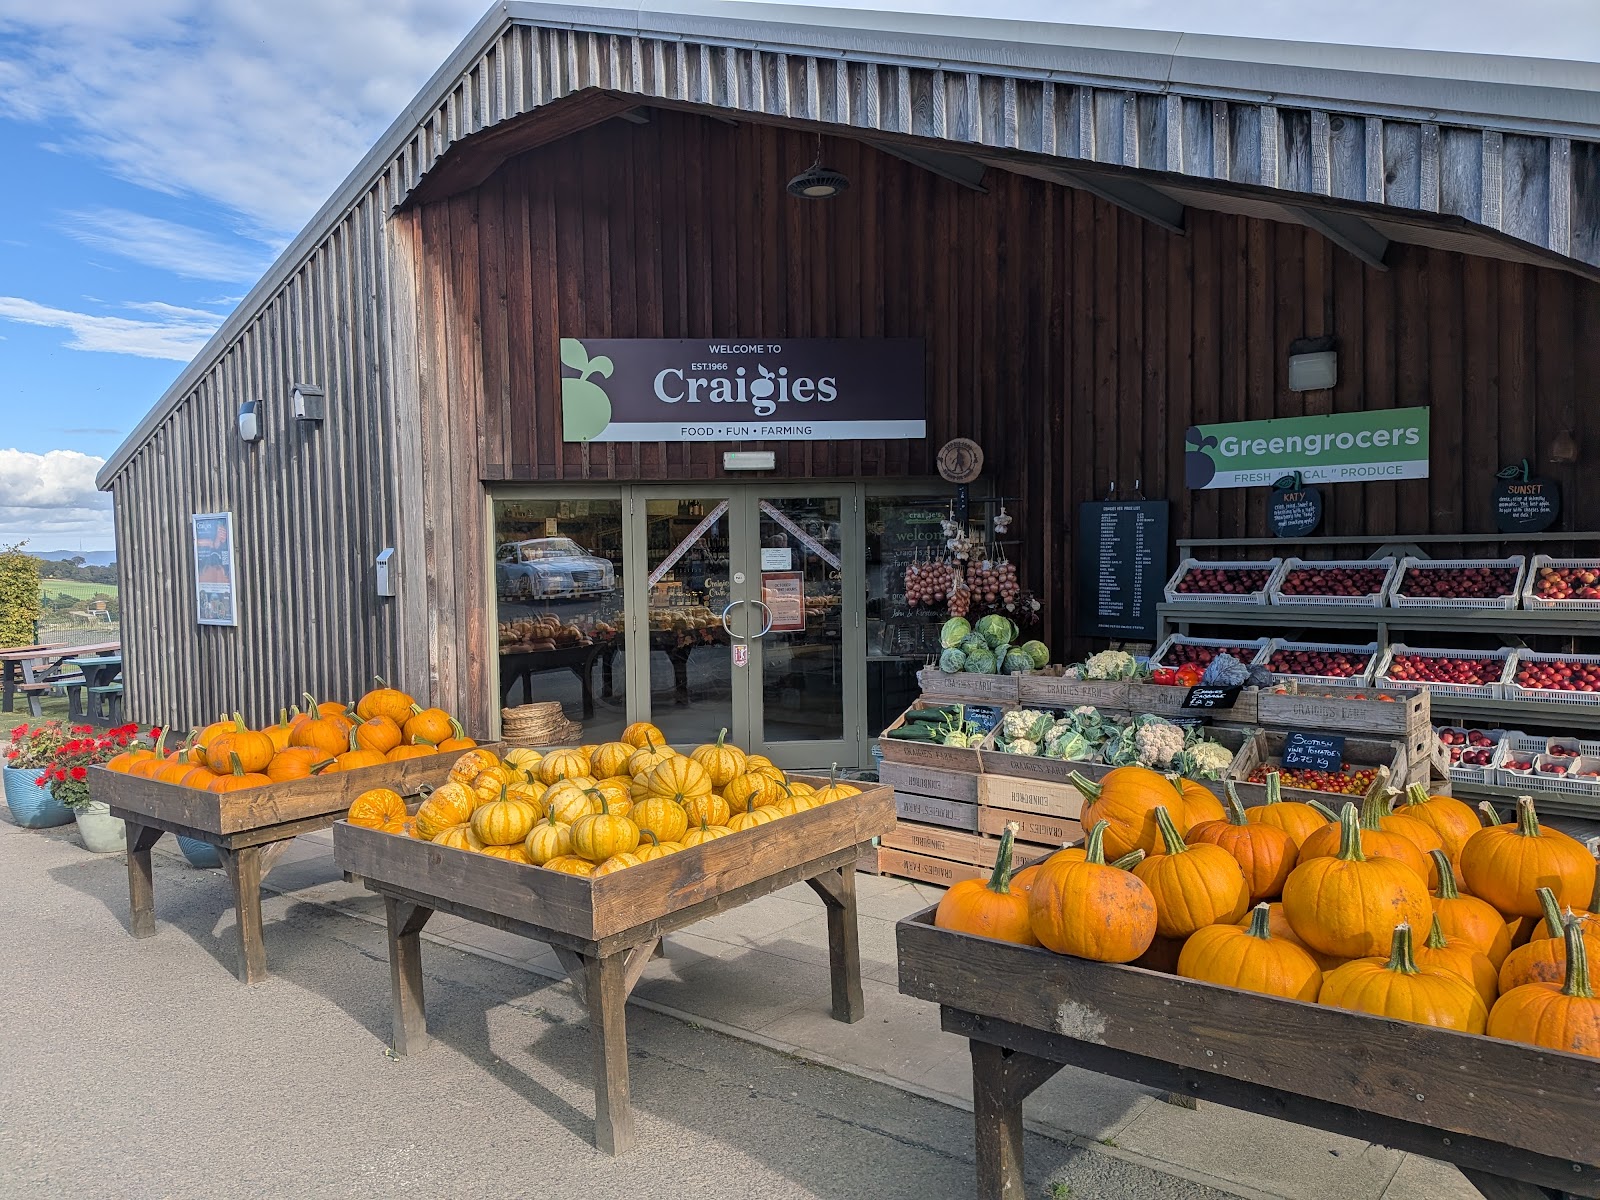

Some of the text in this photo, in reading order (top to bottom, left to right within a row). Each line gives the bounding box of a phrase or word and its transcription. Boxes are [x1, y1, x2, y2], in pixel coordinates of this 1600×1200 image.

[709, 344, 782, 354] WELCOME TO
[691, 362, 728, 371] EST.1966
[653, 362, 838, 416] Craigies
[681, 426, 812, 436] FOOD FUN FARMING
[1220, 427, 1420, 457] Greengrocers
[1234, 472, 1271, 483] FRESH
[1340, 465, 1403, 477] PRODUCE
[1283, 491, 1306, 501] KATY
[1508, 484, 1543, 495] SUNSET
[1047, 684, 1079, 696] CRAIGIES
[1011, 761, 1067, 776] CRAIGIES FARM
[908, 776, 941, 790] EDINBURGH
[1011, 791, 1048, 807] EDINBURGH
[903, 802, 953, 820] CRAIGIES FARM
[1029, 823, 1062, 838] CRAIGIES
[911, 835, 945, 850] EDINBURGH
[903, 859, 953, 879] CRAIGIES FARM
